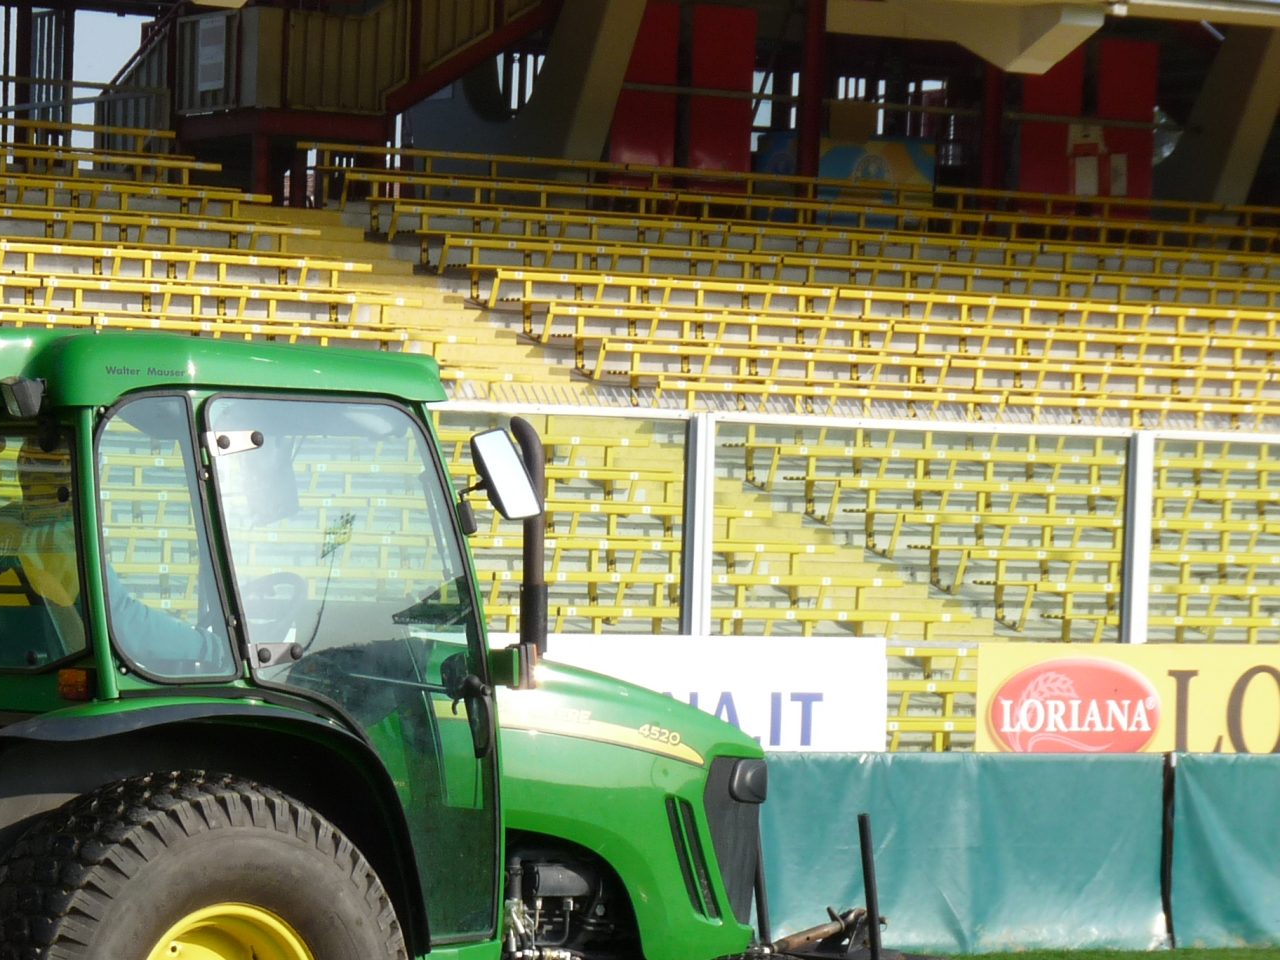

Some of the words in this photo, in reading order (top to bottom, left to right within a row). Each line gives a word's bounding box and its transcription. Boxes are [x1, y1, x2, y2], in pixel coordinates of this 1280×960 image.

[105, 365, 141, 376] Walter
[147, 367, 186, 377] Mauser
[638, 723, 681, 746] 4520
